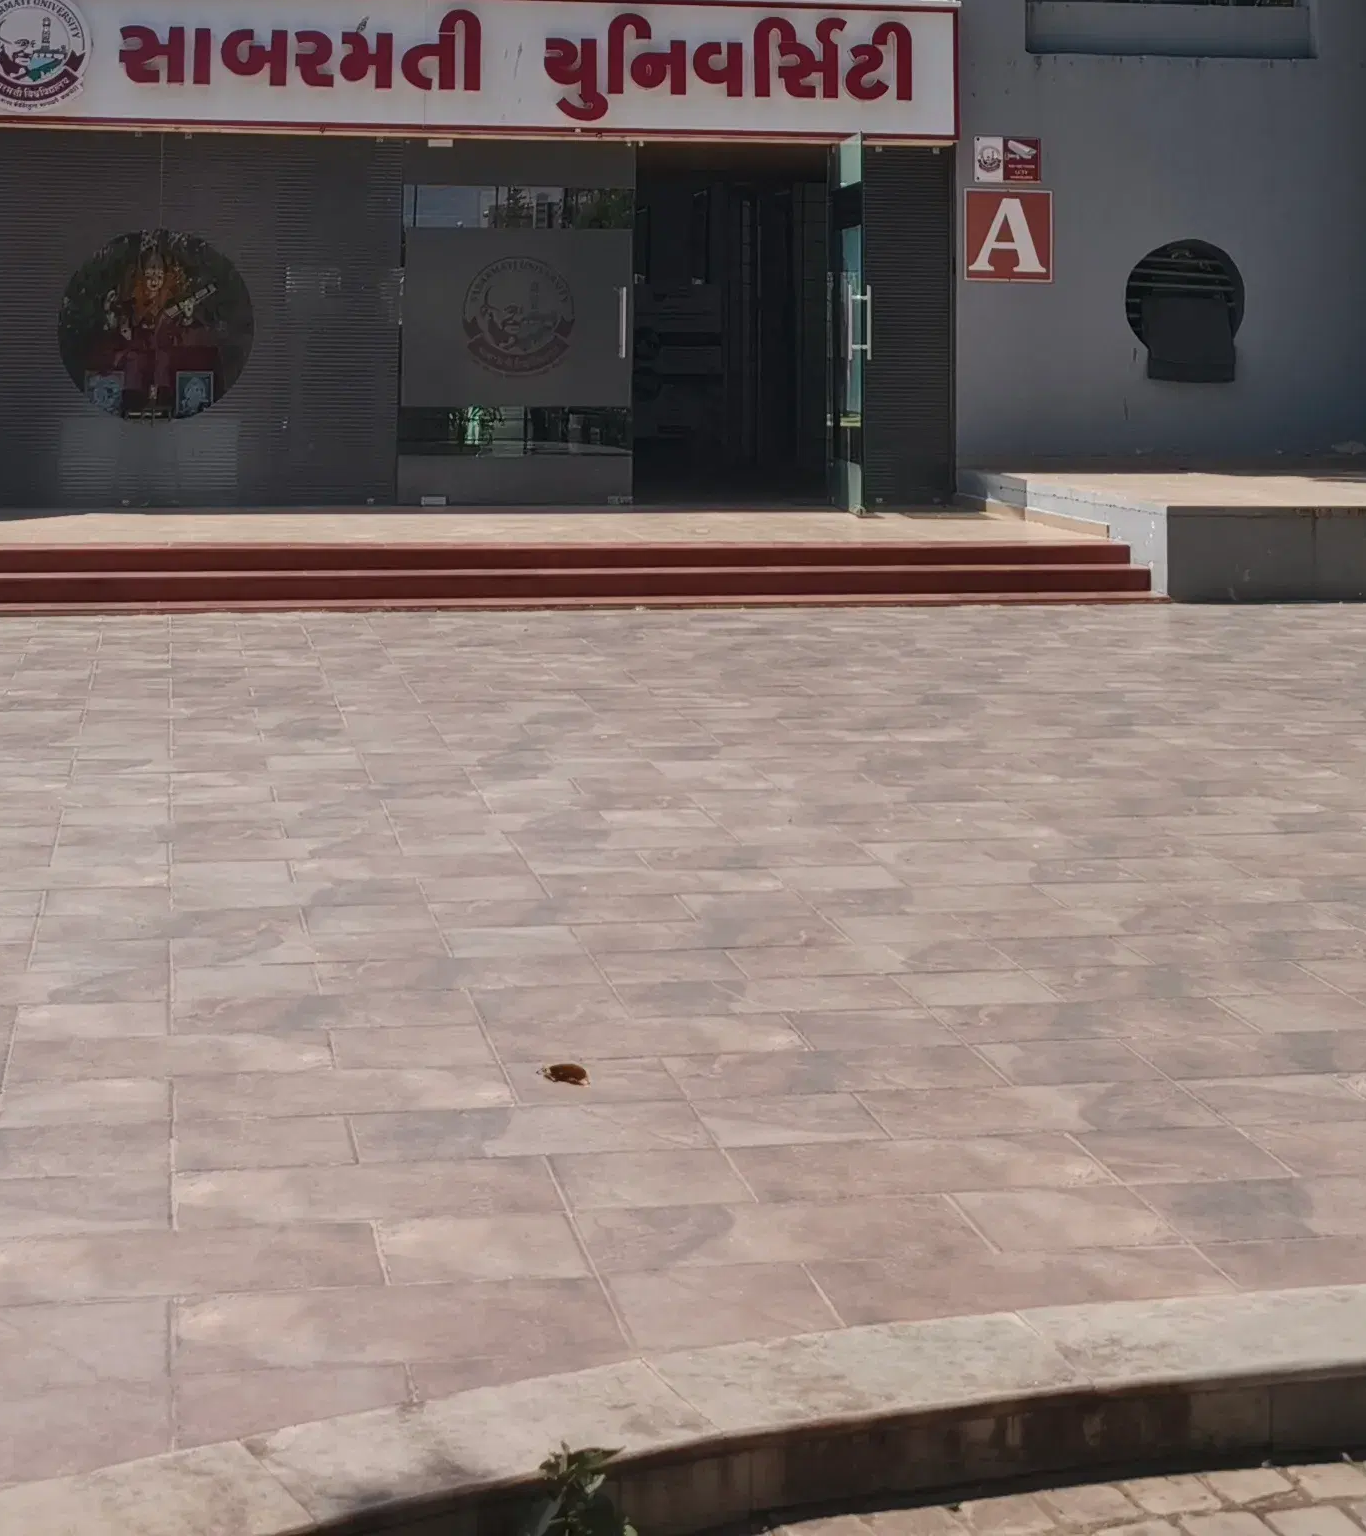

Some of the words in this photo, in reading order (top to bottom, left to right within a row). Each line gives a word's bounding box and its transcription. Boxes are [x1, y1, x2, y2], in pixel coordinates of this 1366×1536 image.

[118, 8, 482, 92] સાબરમતી
[544, 12, 913, 122] યુનિવર્સિટી
[968, 197, 1047, 273] A
